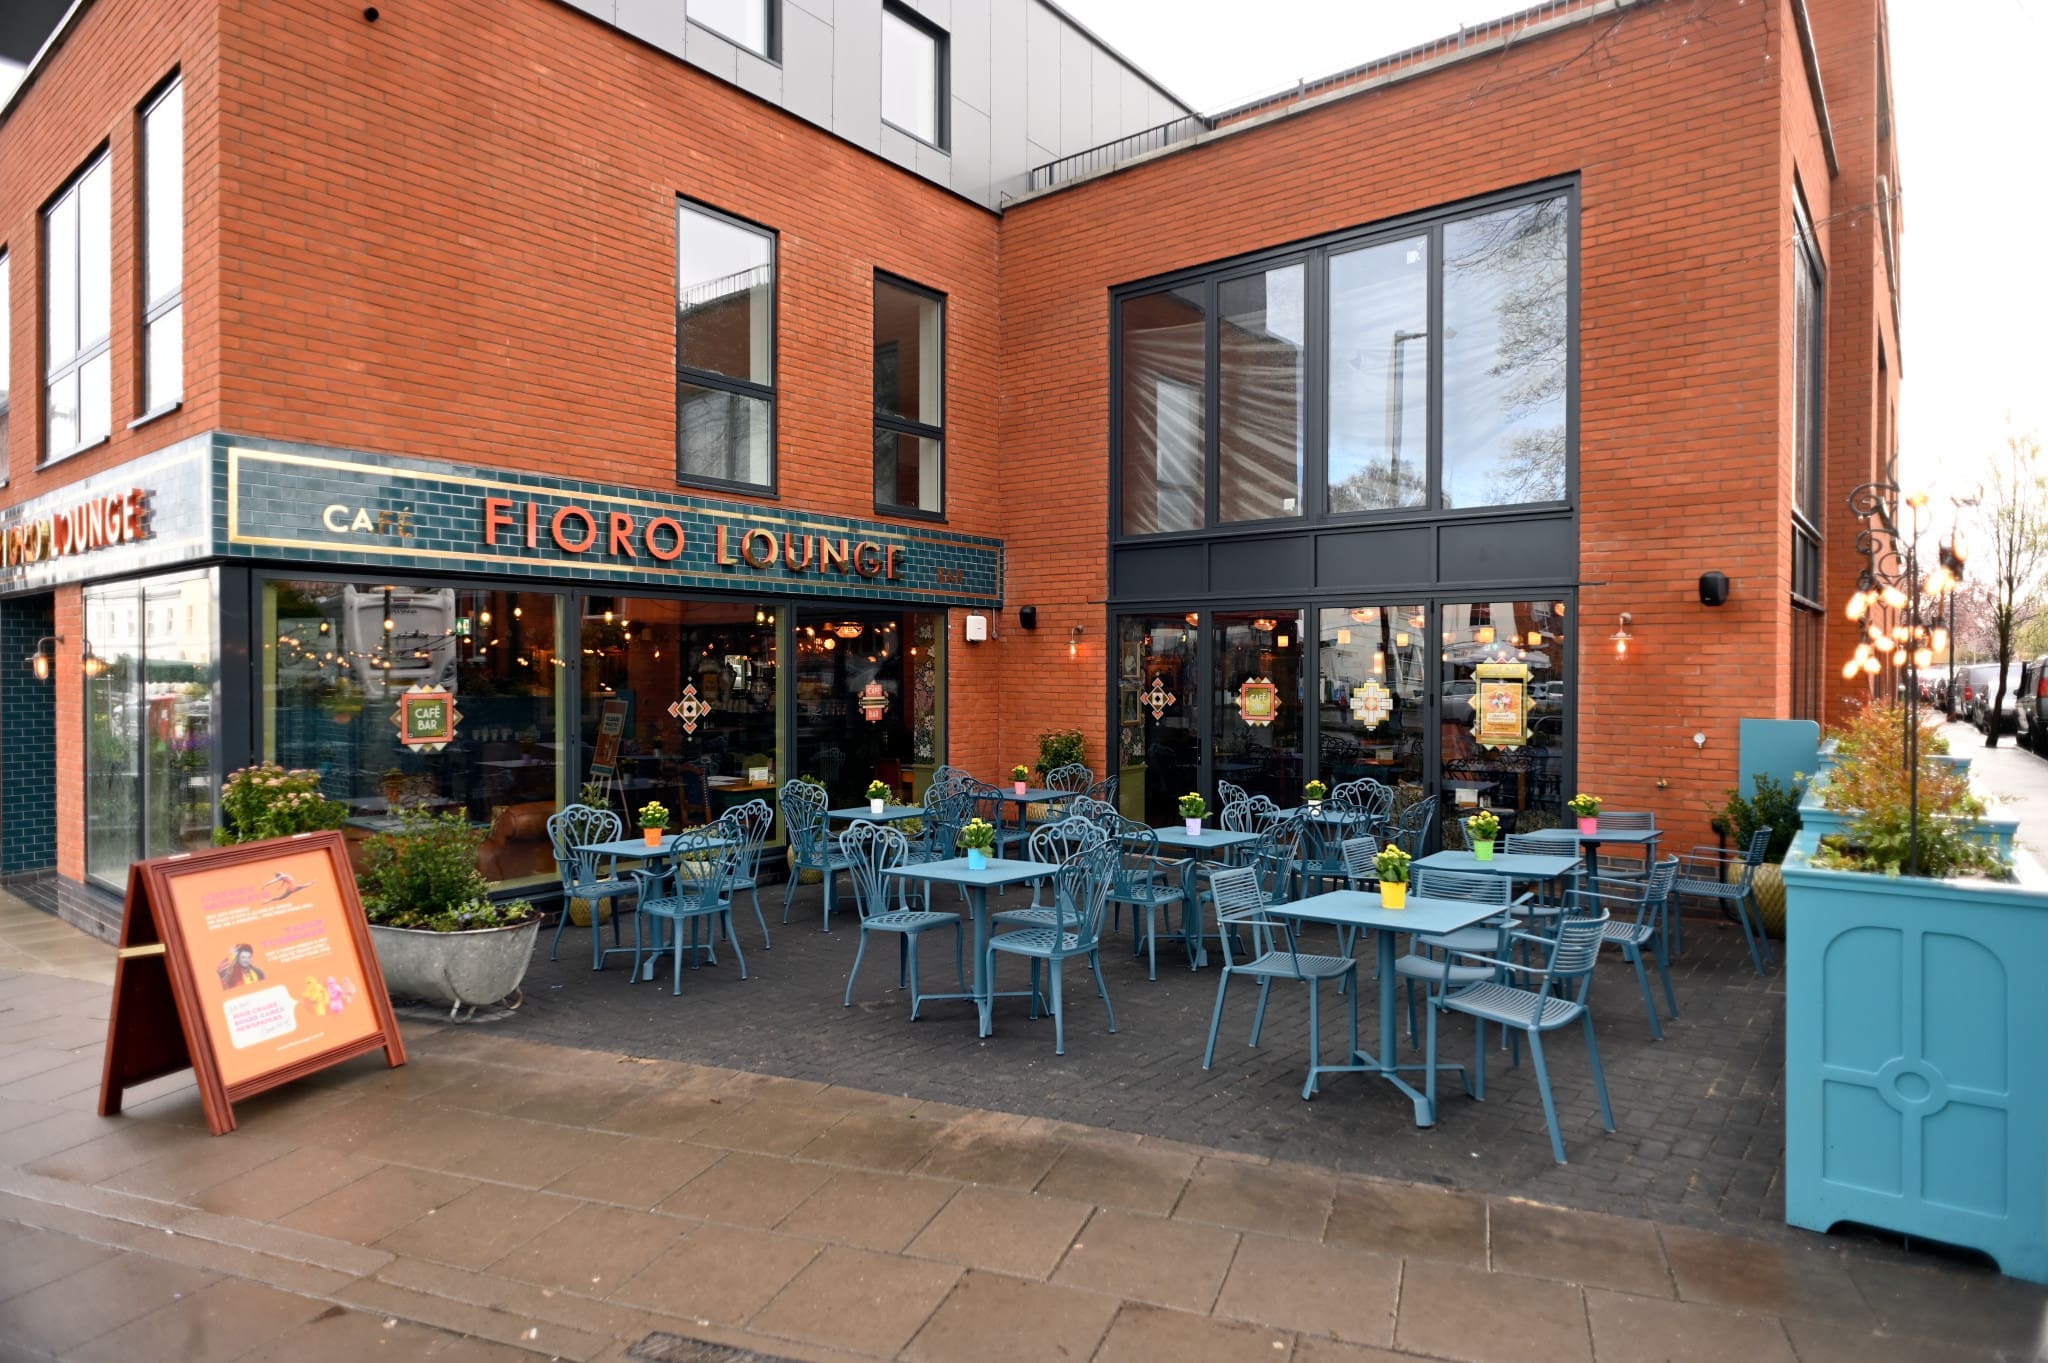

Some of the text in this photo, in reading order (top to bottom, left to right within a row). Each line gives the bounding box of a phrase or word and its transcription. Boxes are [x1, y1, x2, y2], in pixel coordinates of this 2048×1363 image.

[51, 488, 146, 557] LOUNGE
[322, 504, 413, 538] CAFÉ
[484, 497, 906, 580] FIORO LOUNGE
[415, 705, 440, 719] CAFÉ
[418, 720, 437, 730] BAR
